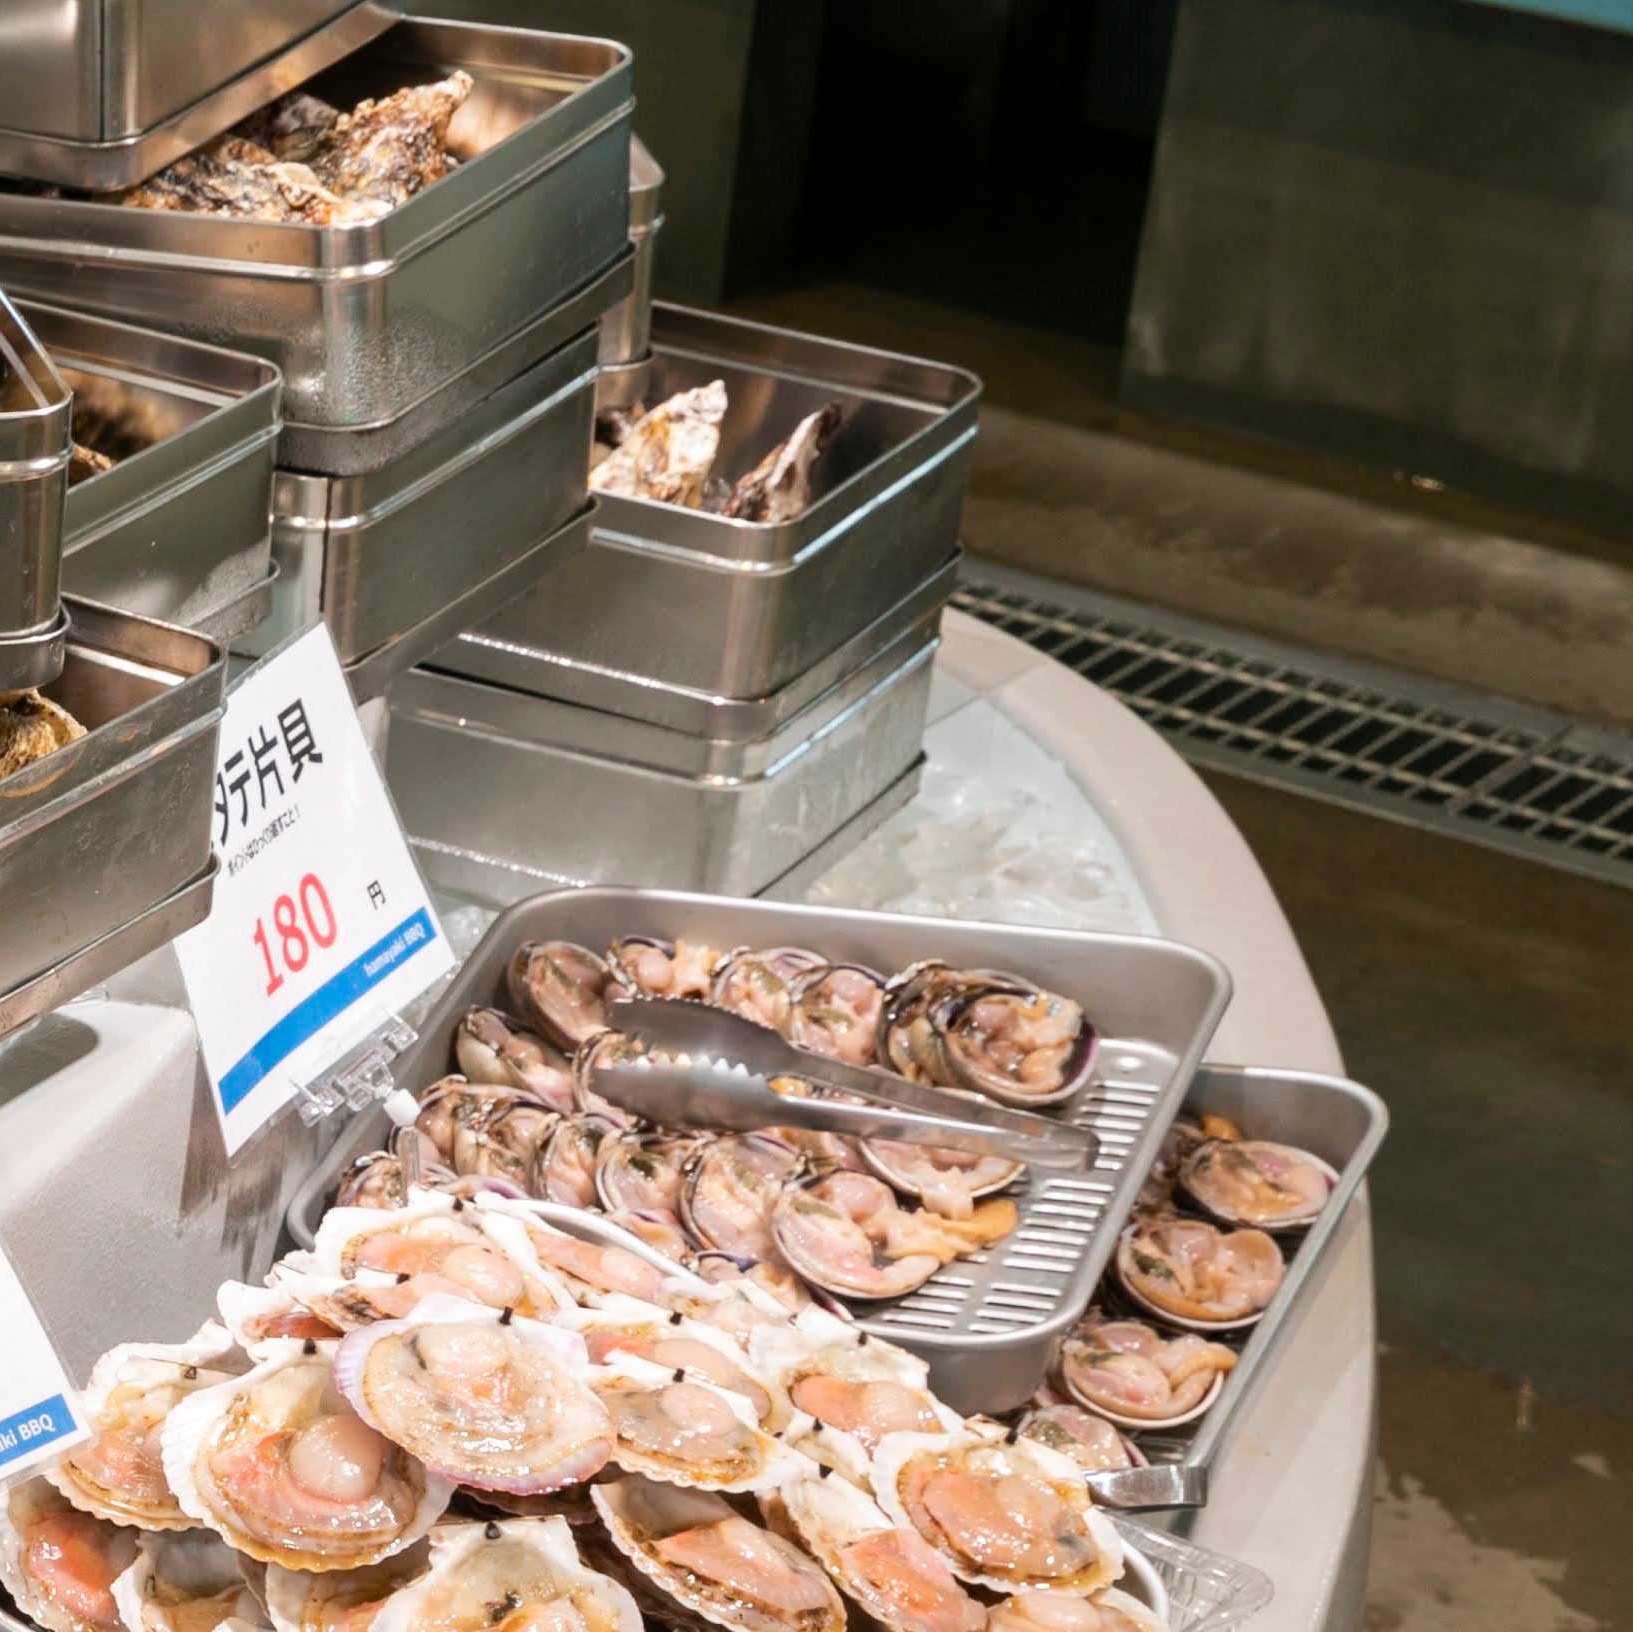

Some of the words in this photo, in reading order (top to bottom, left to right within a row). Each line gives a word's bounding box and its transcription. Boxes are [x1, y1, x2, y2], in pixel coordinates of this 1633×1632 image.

[211, 697, 323, 849] タテ片貝
[252, 871, 338, 996] 180
[367, 880, 386, 910] 円
[18, 1413, 57, 1444] BBQ
